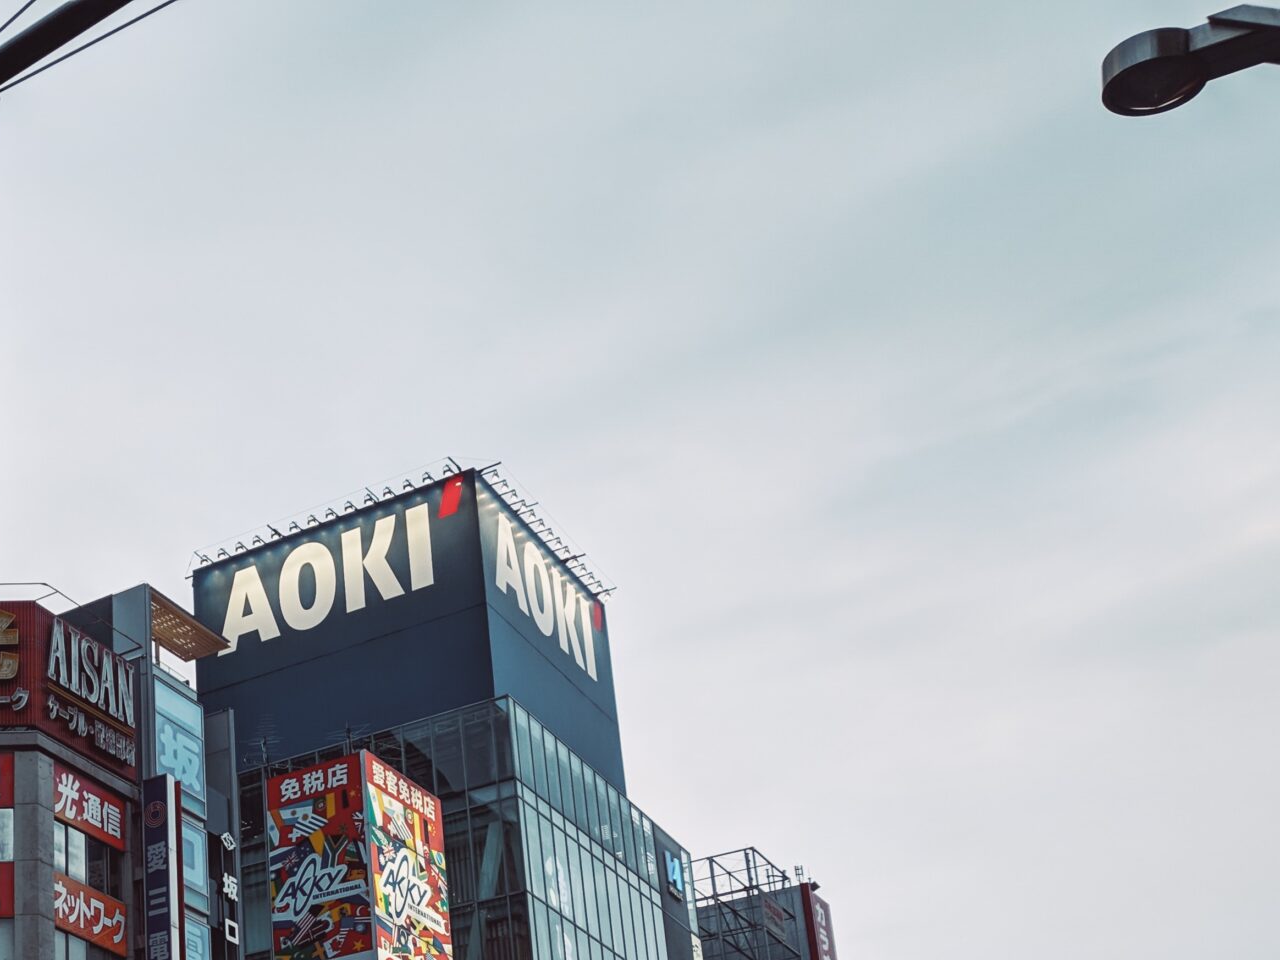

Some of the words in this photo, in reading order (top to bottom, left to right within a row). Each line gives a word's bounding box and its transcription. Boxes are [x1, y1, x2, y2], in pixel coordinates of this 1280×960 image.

[217, 501, 435, 658] AOKI
[495, 511, 599, 683] AOKI
[47, 616, 136, 729] AISAN
[53, 772, 122, 840] 光通信
[279, 763, 349, 803] 免税店
[53, 881, 126, 944] ネットワーク
[312, 883, 363, 901] INTERNATIONAL
